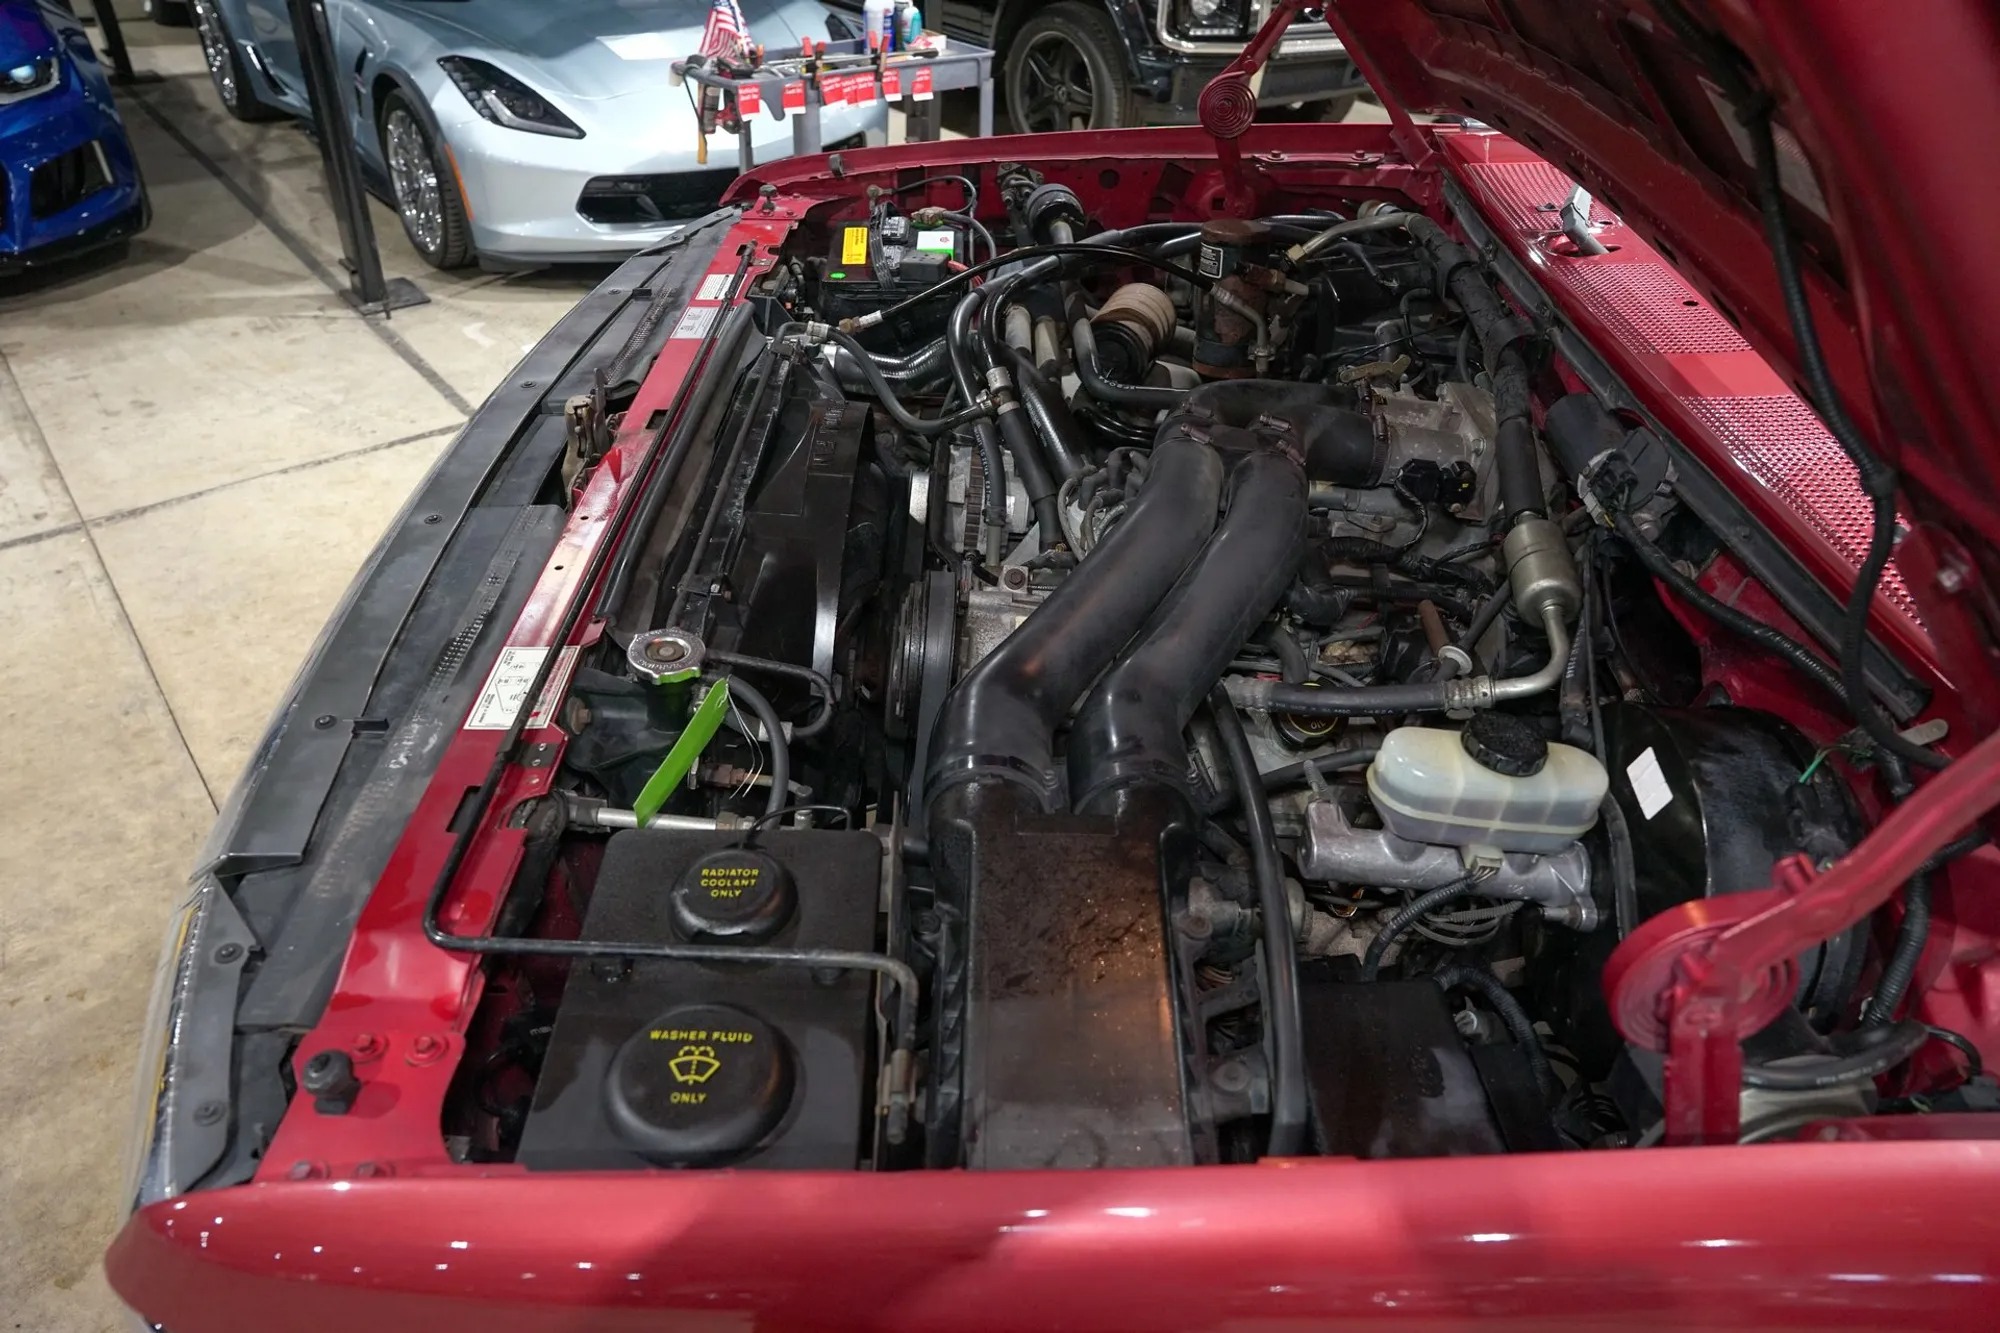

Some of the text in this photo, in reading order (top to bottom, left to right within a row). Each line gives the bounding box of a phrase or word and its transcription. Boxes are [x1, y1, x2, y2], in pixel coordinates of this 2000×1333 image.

[701, 868, 760, 877] RADIATOR
[700, 879, 757, 887] COOLANT
[710, 889, 742, 898] ONLY
[650, 1029, 753, 1043] WASHER FLUID
[669, 1091, 707, 1104] ONLY
